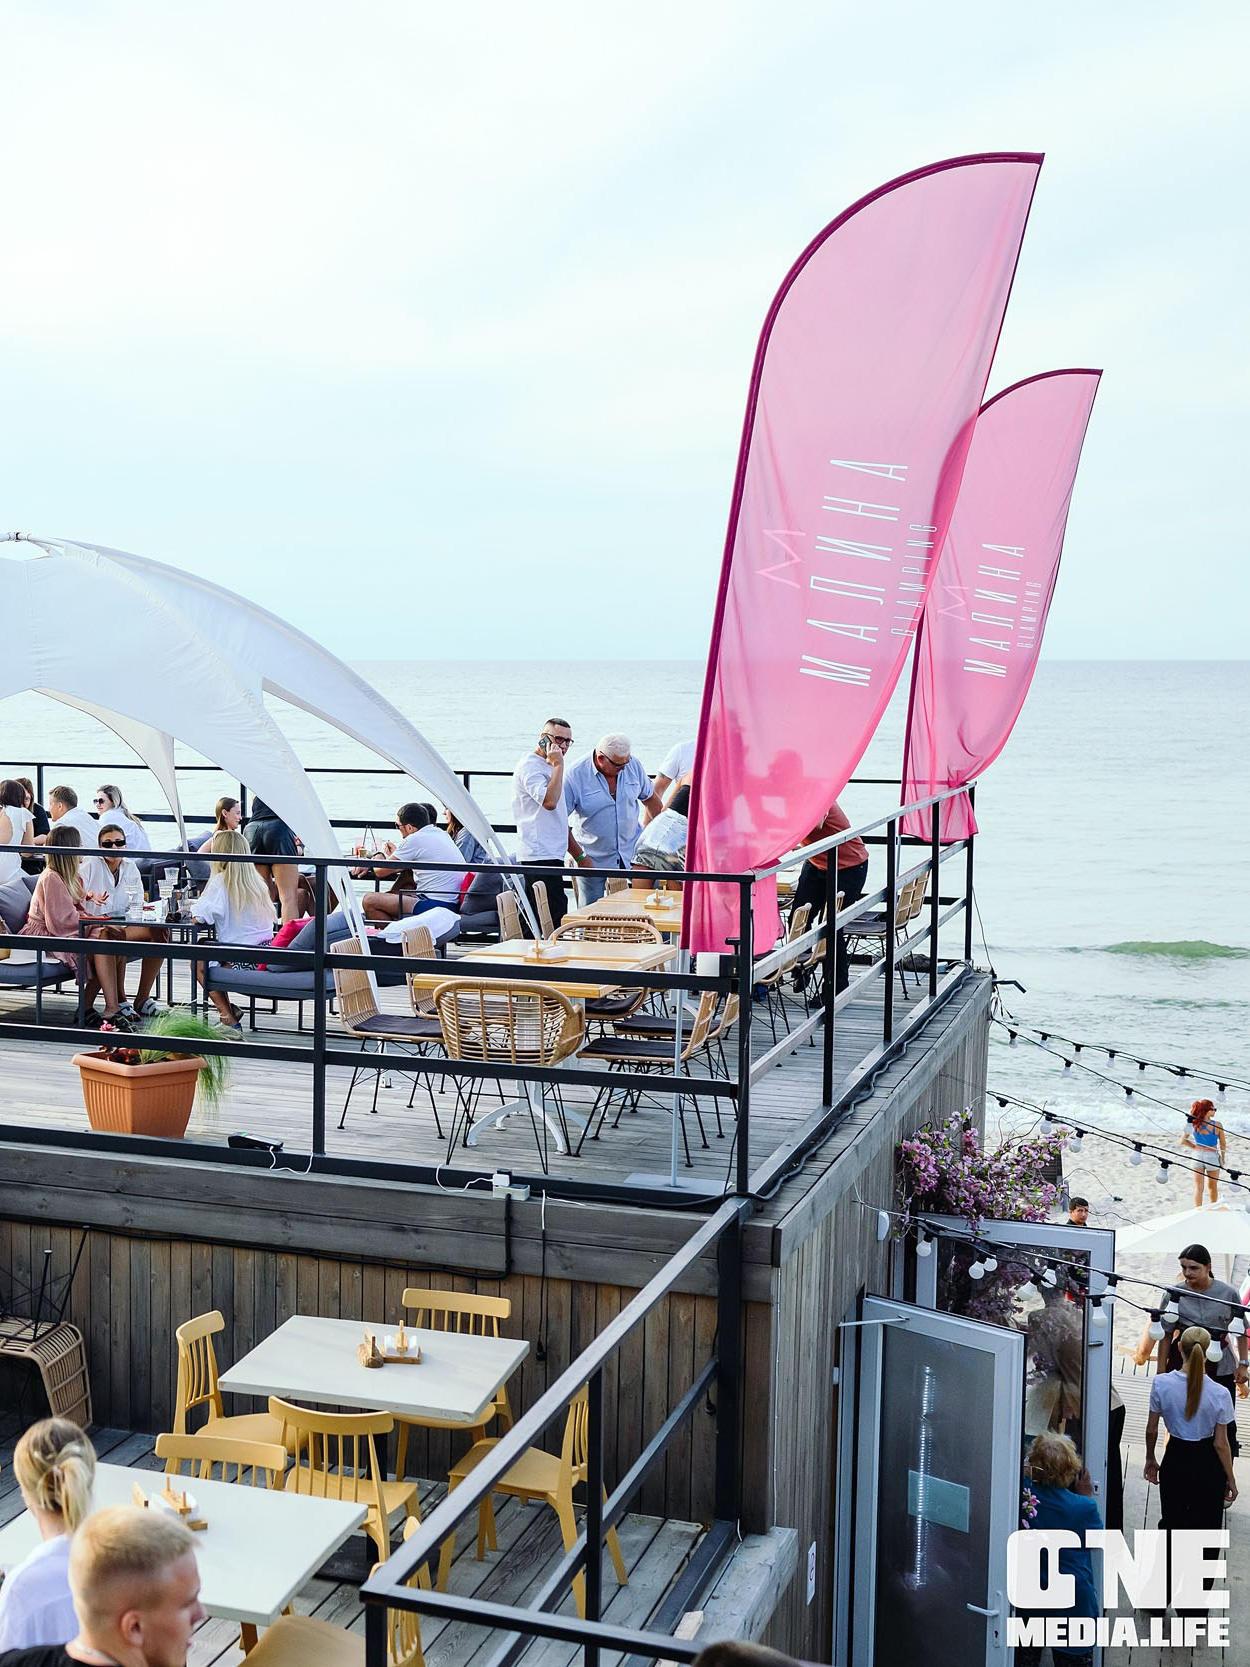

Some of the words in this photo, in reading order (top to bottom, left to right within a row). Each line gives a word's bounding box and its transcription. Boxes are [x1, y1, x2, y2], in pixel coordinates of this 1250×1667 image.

[800, 459, 908, 687] МАЛИНА
[890, 523, 938, 637] GLAMPING
[963, 543, 1025, 678] МАЛИНА
[1016, 580, 1042, 649] GLAMPING
